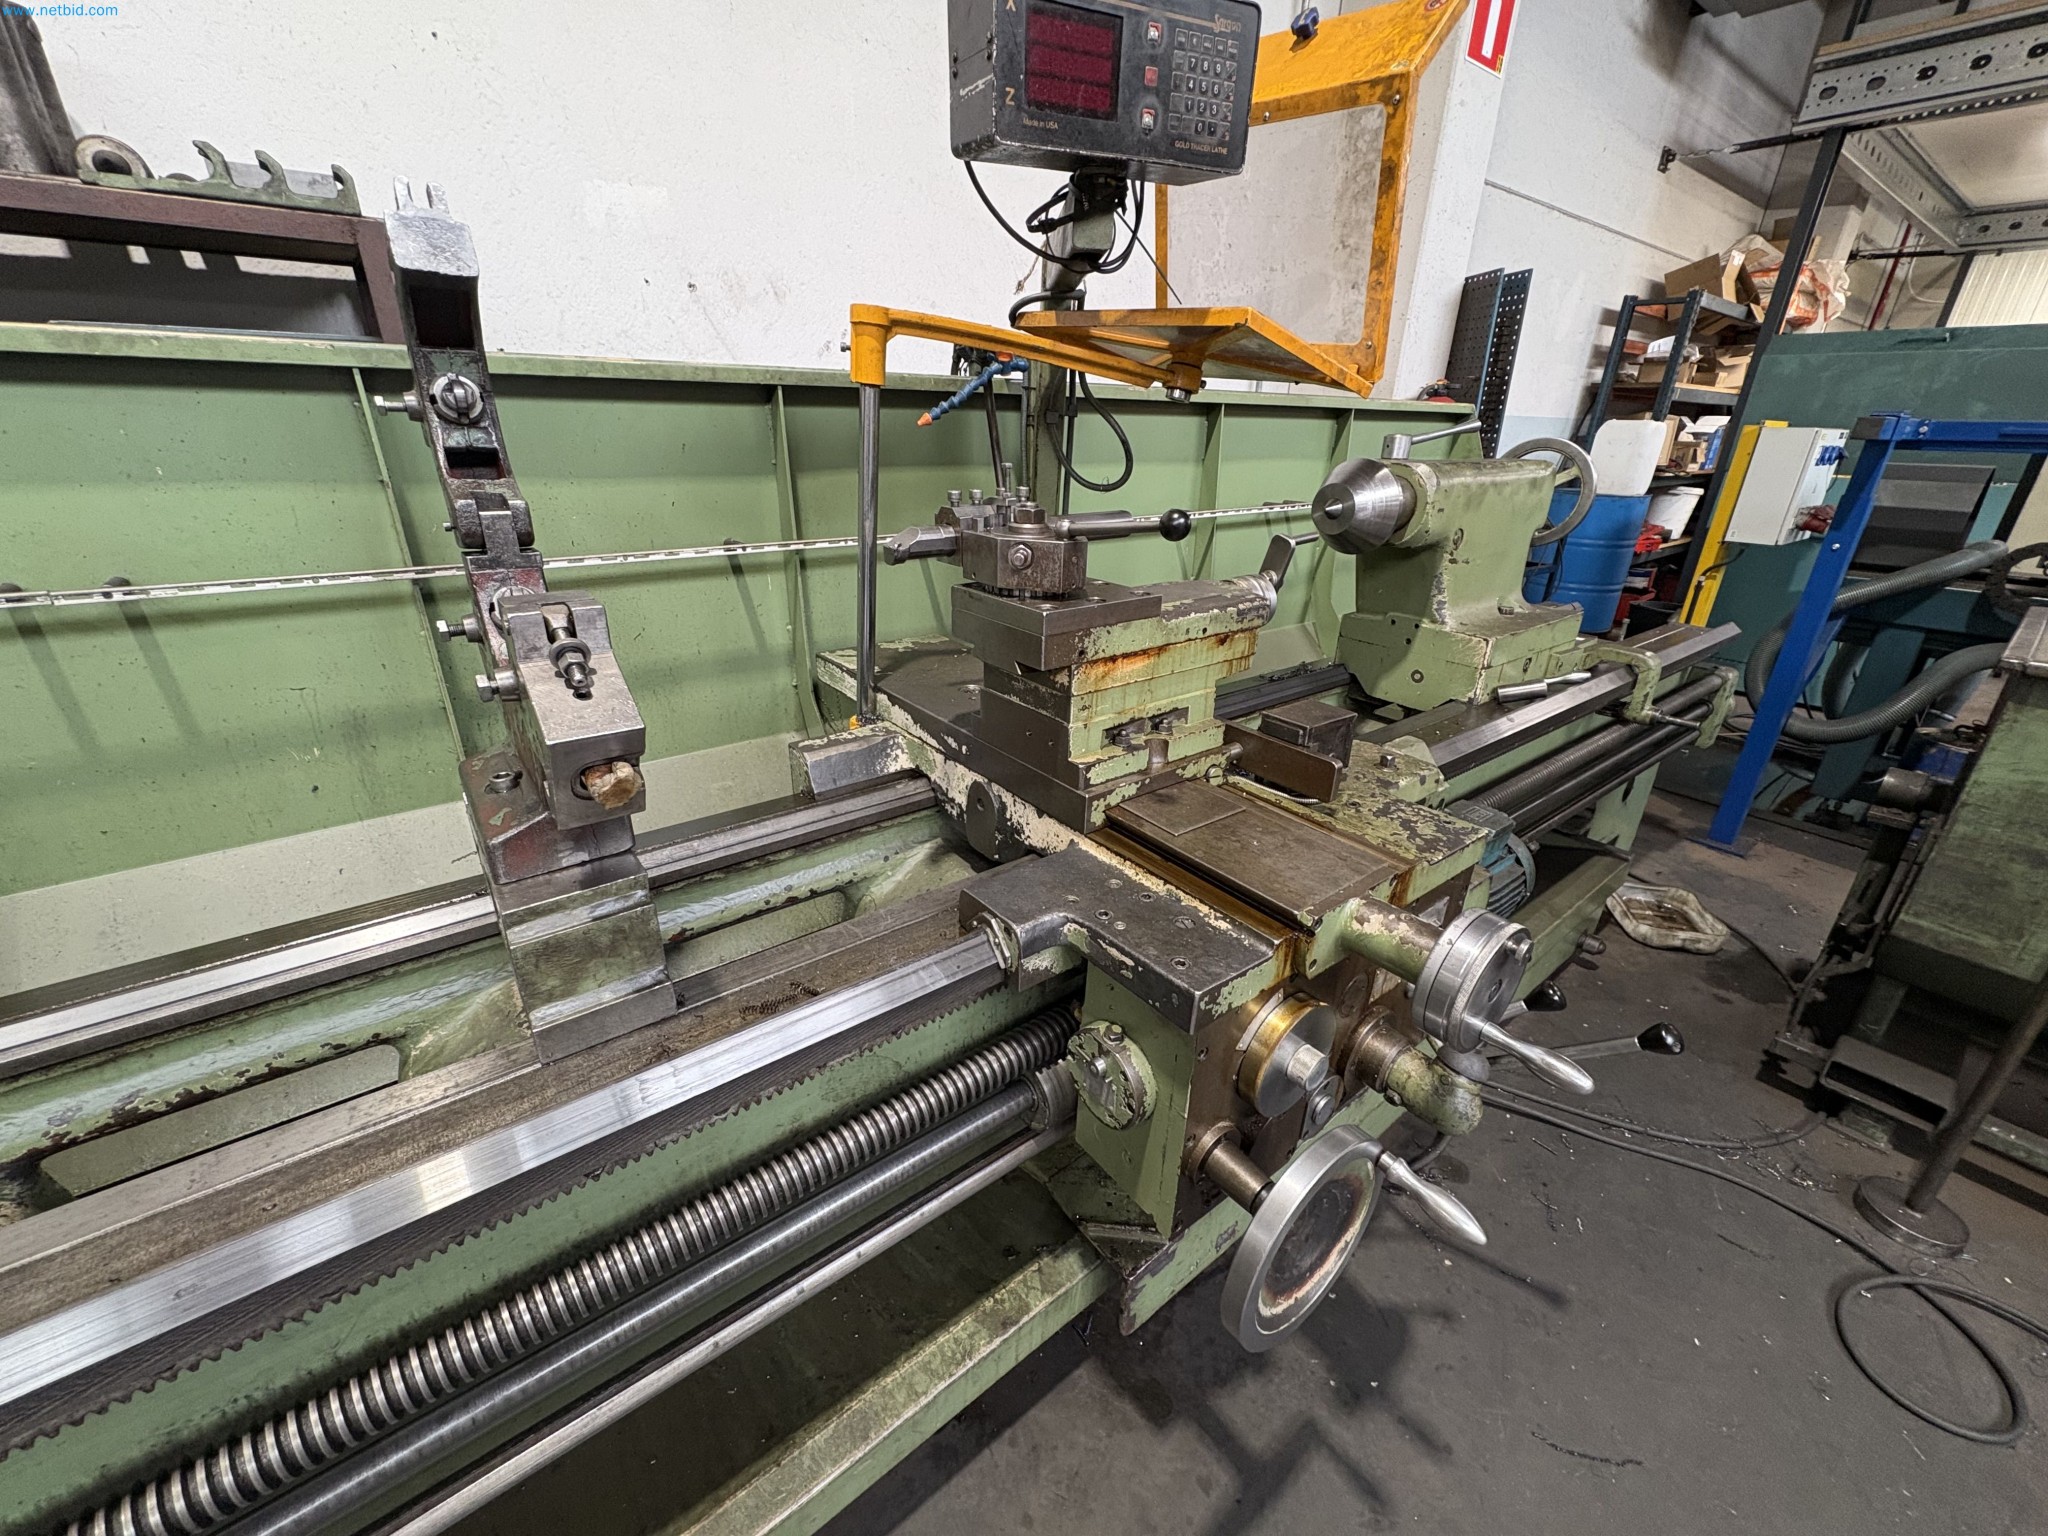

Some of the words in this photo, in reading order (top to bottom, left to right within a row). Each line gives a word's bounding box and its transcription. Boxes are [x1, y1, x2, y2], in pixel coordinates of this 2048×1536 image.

[1190, 58, 1196, 68] 7
[1203, 61, 1209, 71] 8
[1216, 63, 1221, 74] 9
[1188, 80, 1194, 89] 4
[1201, 82, 1207, 92] 5
[1213, 84, 1219, 94] 6
[1005, 87, 1015, 105] Z
[1187, 101, 1191, 109] 1
[1200, 102, 1205, 112] 2
[1212, 105, 1217, 115] 3
[1023, 117, 1038, 127] Made
[1045, 120, 1059, 130] USA
[1197, 122, 1203, 132] 0
[1174, 140, 1190, 149] GOLD
[1211, 146, 1228, 155] LATHE
